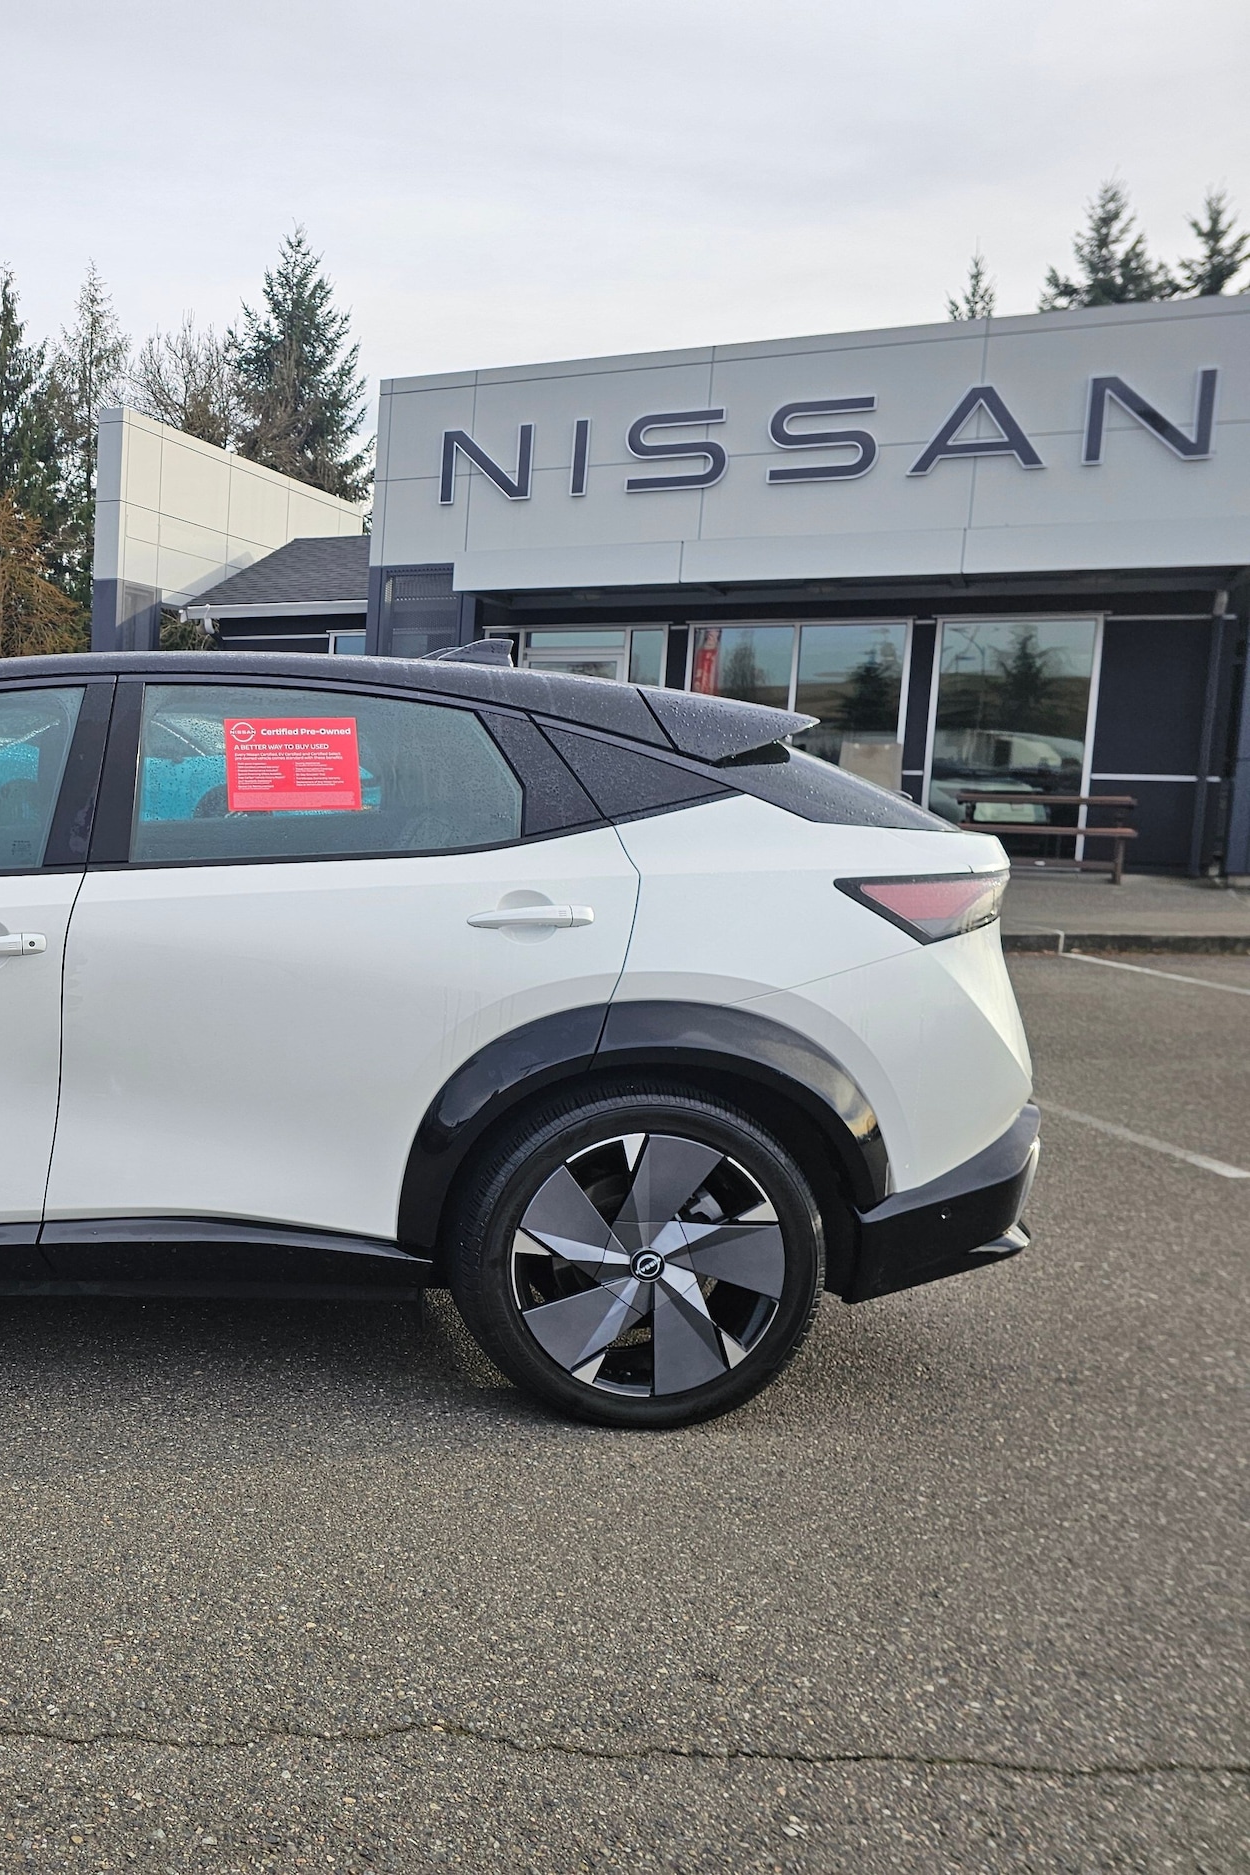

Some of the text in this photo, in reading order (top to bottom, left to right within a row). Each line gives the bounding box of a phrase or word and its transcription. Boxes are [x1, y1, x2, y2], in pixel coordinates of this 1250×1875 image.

[439, 367, 1220, 505] NISSAN
[261, 727, 351, 736] Certified Pre-Owned
